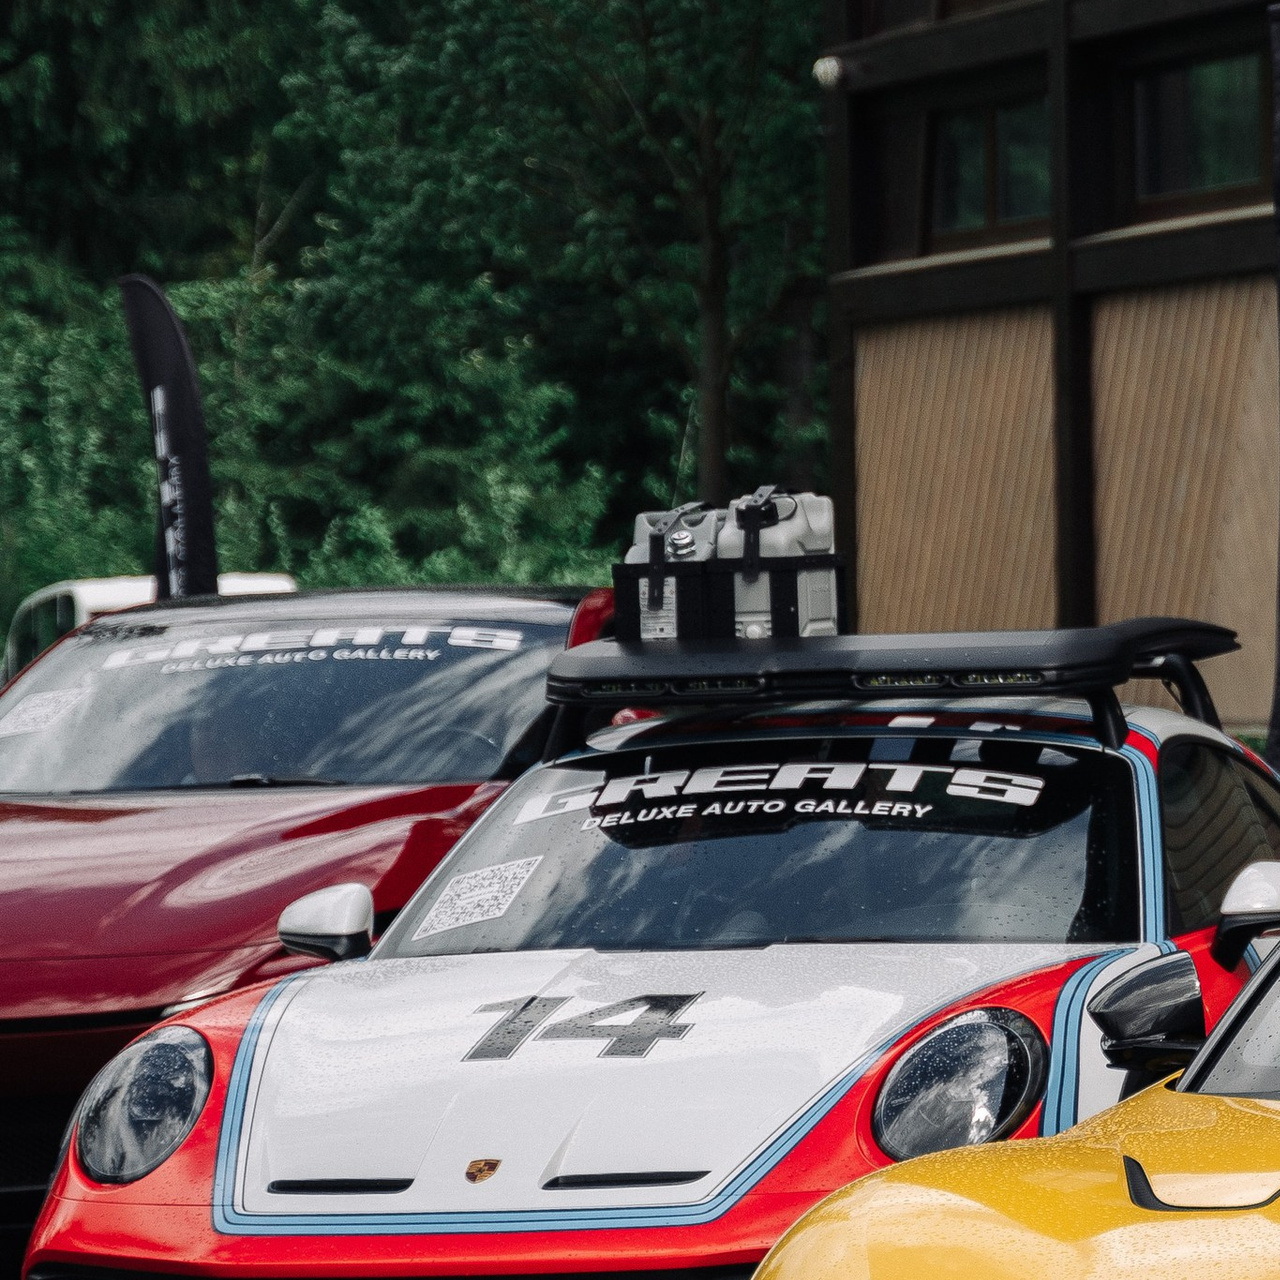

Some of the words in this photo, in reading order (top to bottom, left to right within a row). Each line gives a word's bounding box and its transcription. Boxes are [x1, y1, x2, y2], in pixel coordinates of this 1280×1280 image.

[102, 626, 523, 670] GREATS
[160, 654, 253, 674] DELUXE
[257, 648, 326, 665] AUTO
[332, 647, 442, 662] GALLERY
[513, 762, 1046, 825] GREATS
[580, 803, 698, 832] DELUXE
[701, 798, 784, 817] AUTO
[794, 798, 934, 819] GALLERY
[460, 990, 707, 1062] 14
